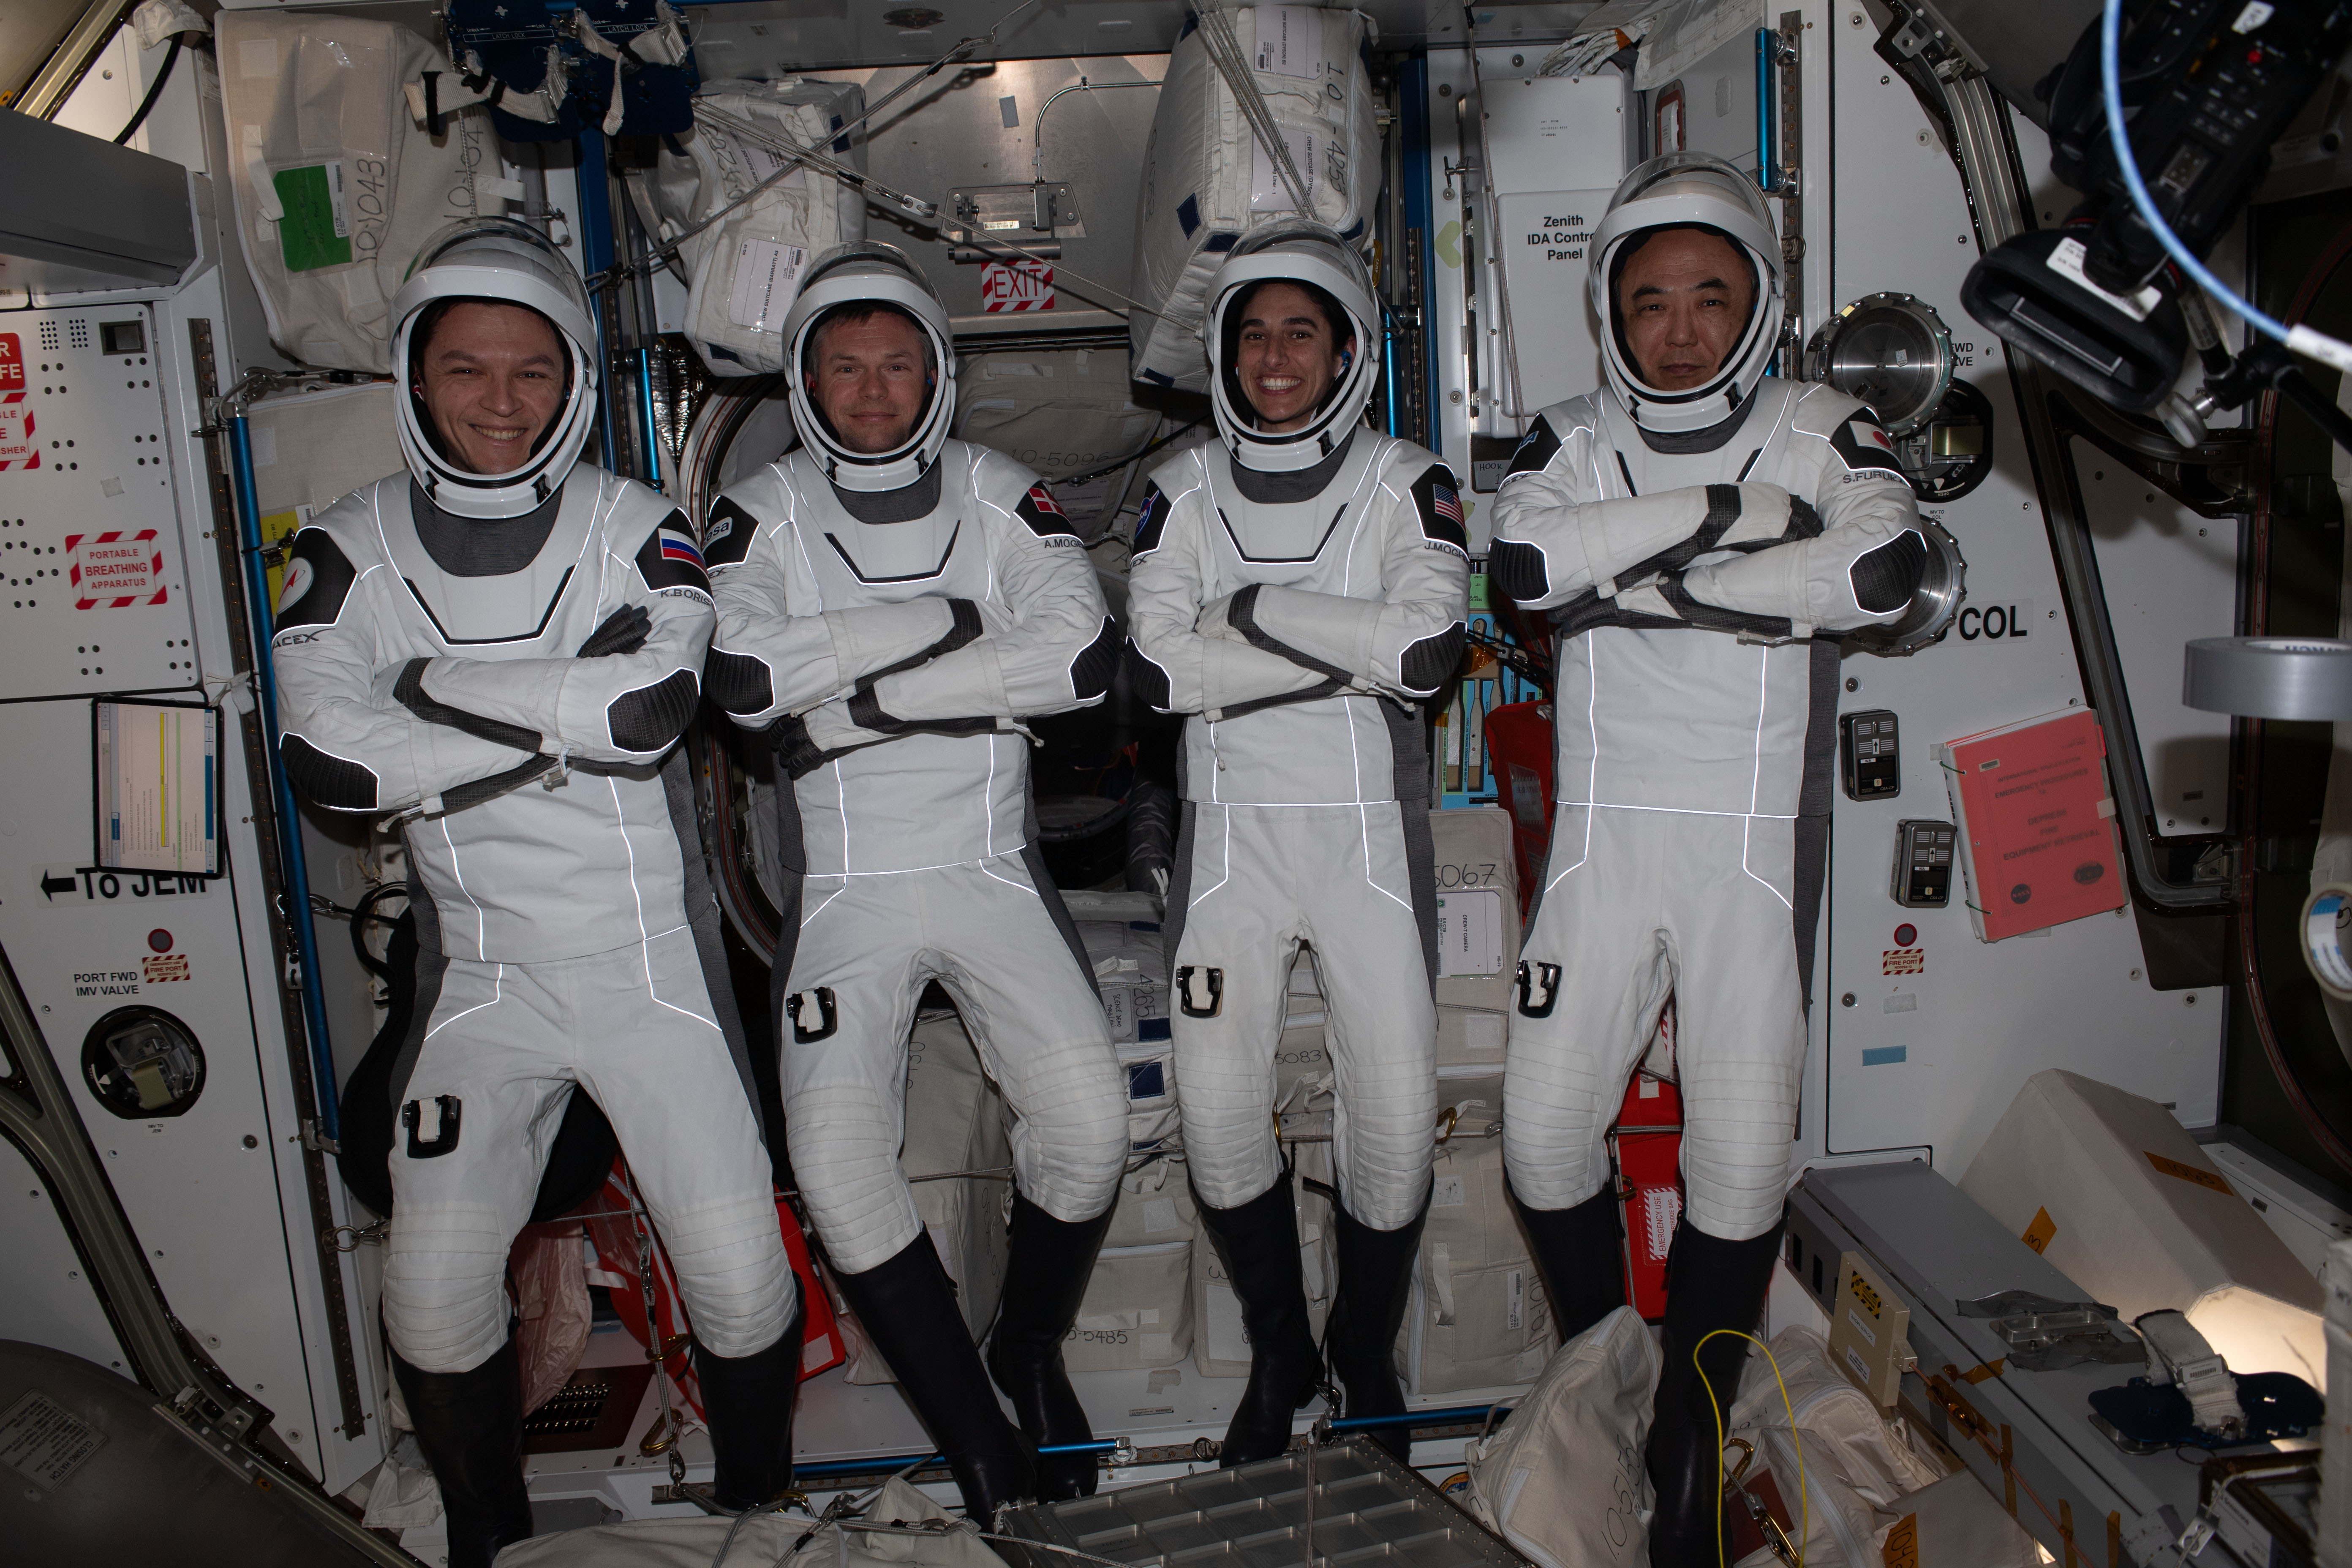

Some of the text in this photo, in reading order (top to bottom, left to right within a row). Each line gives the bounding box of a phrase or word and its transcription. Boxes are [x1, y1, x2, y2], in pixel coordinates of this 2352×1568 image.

[607, 24, 649, 37] LATCH LOCK
[1544, 215, 1583, 227] Zenith
[1527, 231, 1595, 245] IDA Contr
[1548, 248, 1582, 260] Panel
[768, 257, 779, 283] (BARRATT)
[993, 268, 1042, 298] EXIT
[764, 283, 773, 307] SUITCASE
[1495, 474, 1502, 485] 1
[89, 549, 139, 559] PORTABLE
[85, 562, 148, 576] BREATHING
[91, 578, 146, 589] APPARATUS
[1959, 605, 2028, 640] COL
[1995, 782, 2038, 799] EMERGENCY
[2003, 841, 2051, 860] EQUIPMENT
[131, 874, 207, 897] JEM
[74, 972, 138, 983] PORT FWD
[76, 985, 139, 996] IMV VALVE
[1113, 994, 1121, 1015] SCIENCE
[1654, 1196, 1666, 1252] EMERGENCY USE
[1851, 1314, 1860, 1327] MOVE
[1867, 1333, 1873, 1341] DO
[49, 1440, 94, 1481] CLOSING HATCH
